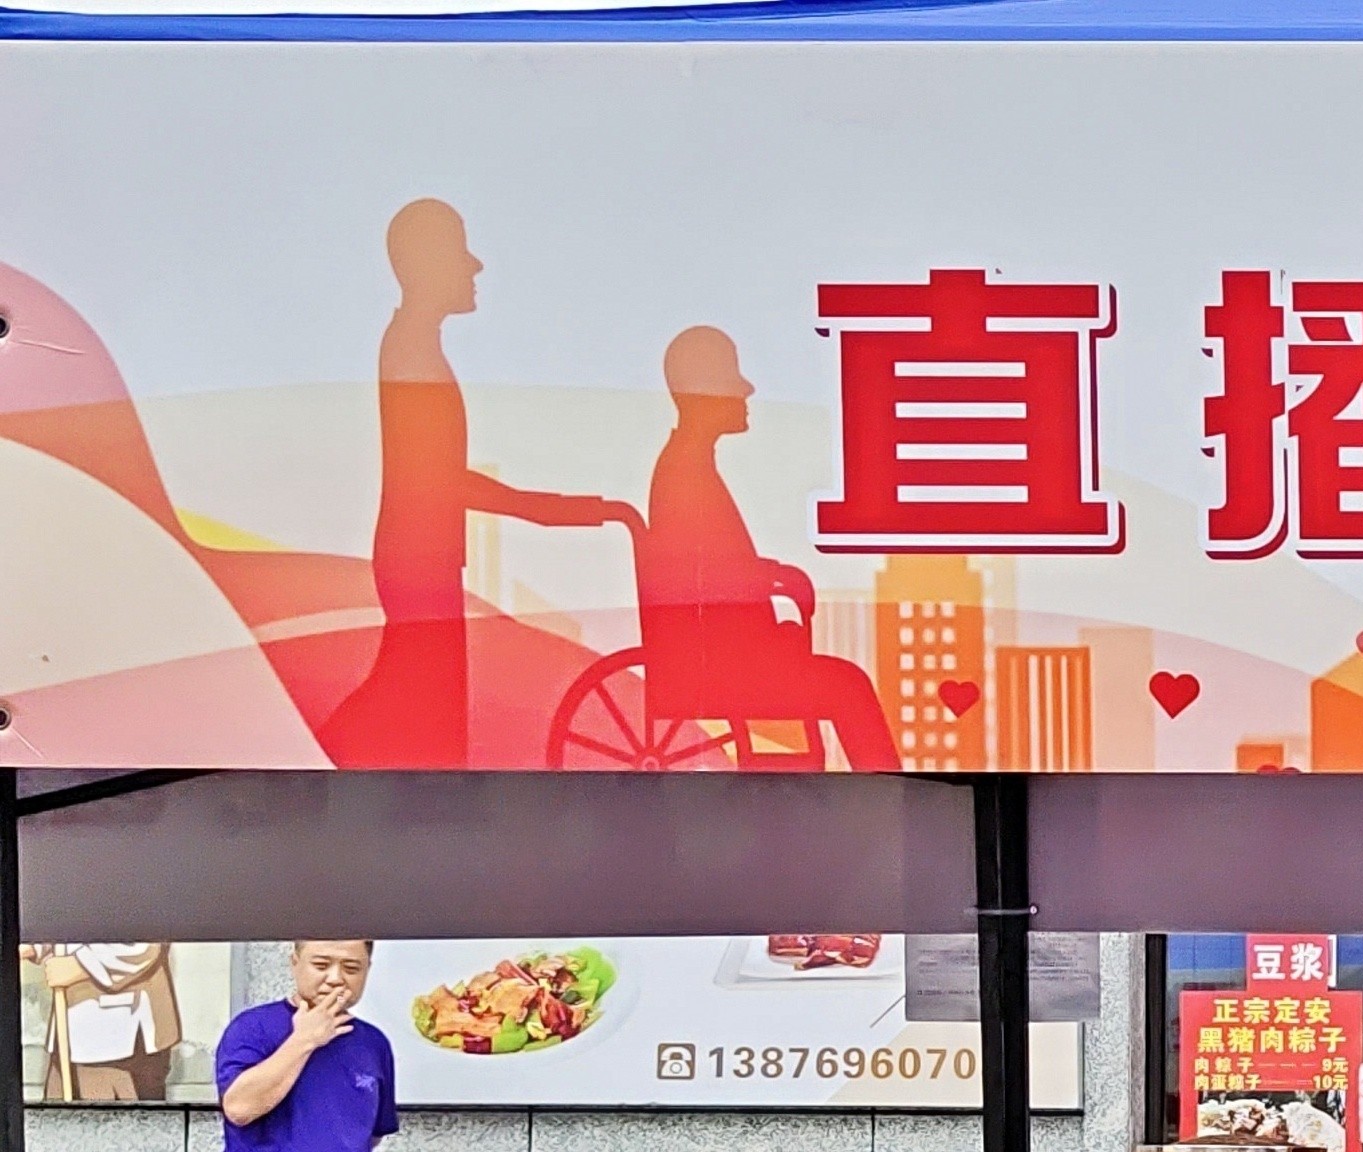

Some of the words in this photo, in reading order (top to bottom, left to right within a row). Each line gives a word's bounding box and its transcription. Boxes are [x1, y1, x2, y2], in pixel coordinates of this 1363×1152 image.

[1252, 942, 1325, 981] 豆浆
[1212, 997, 1332, 1024] 正宗定安
[1197, 1027, 1347, 1054] 黑猪肉粽子
[708, 1046, 977, 1080] 1387696070
[1322, 1057, 1349, 1073] 9元
[1313, 1075, 1349, 1091] 10元
